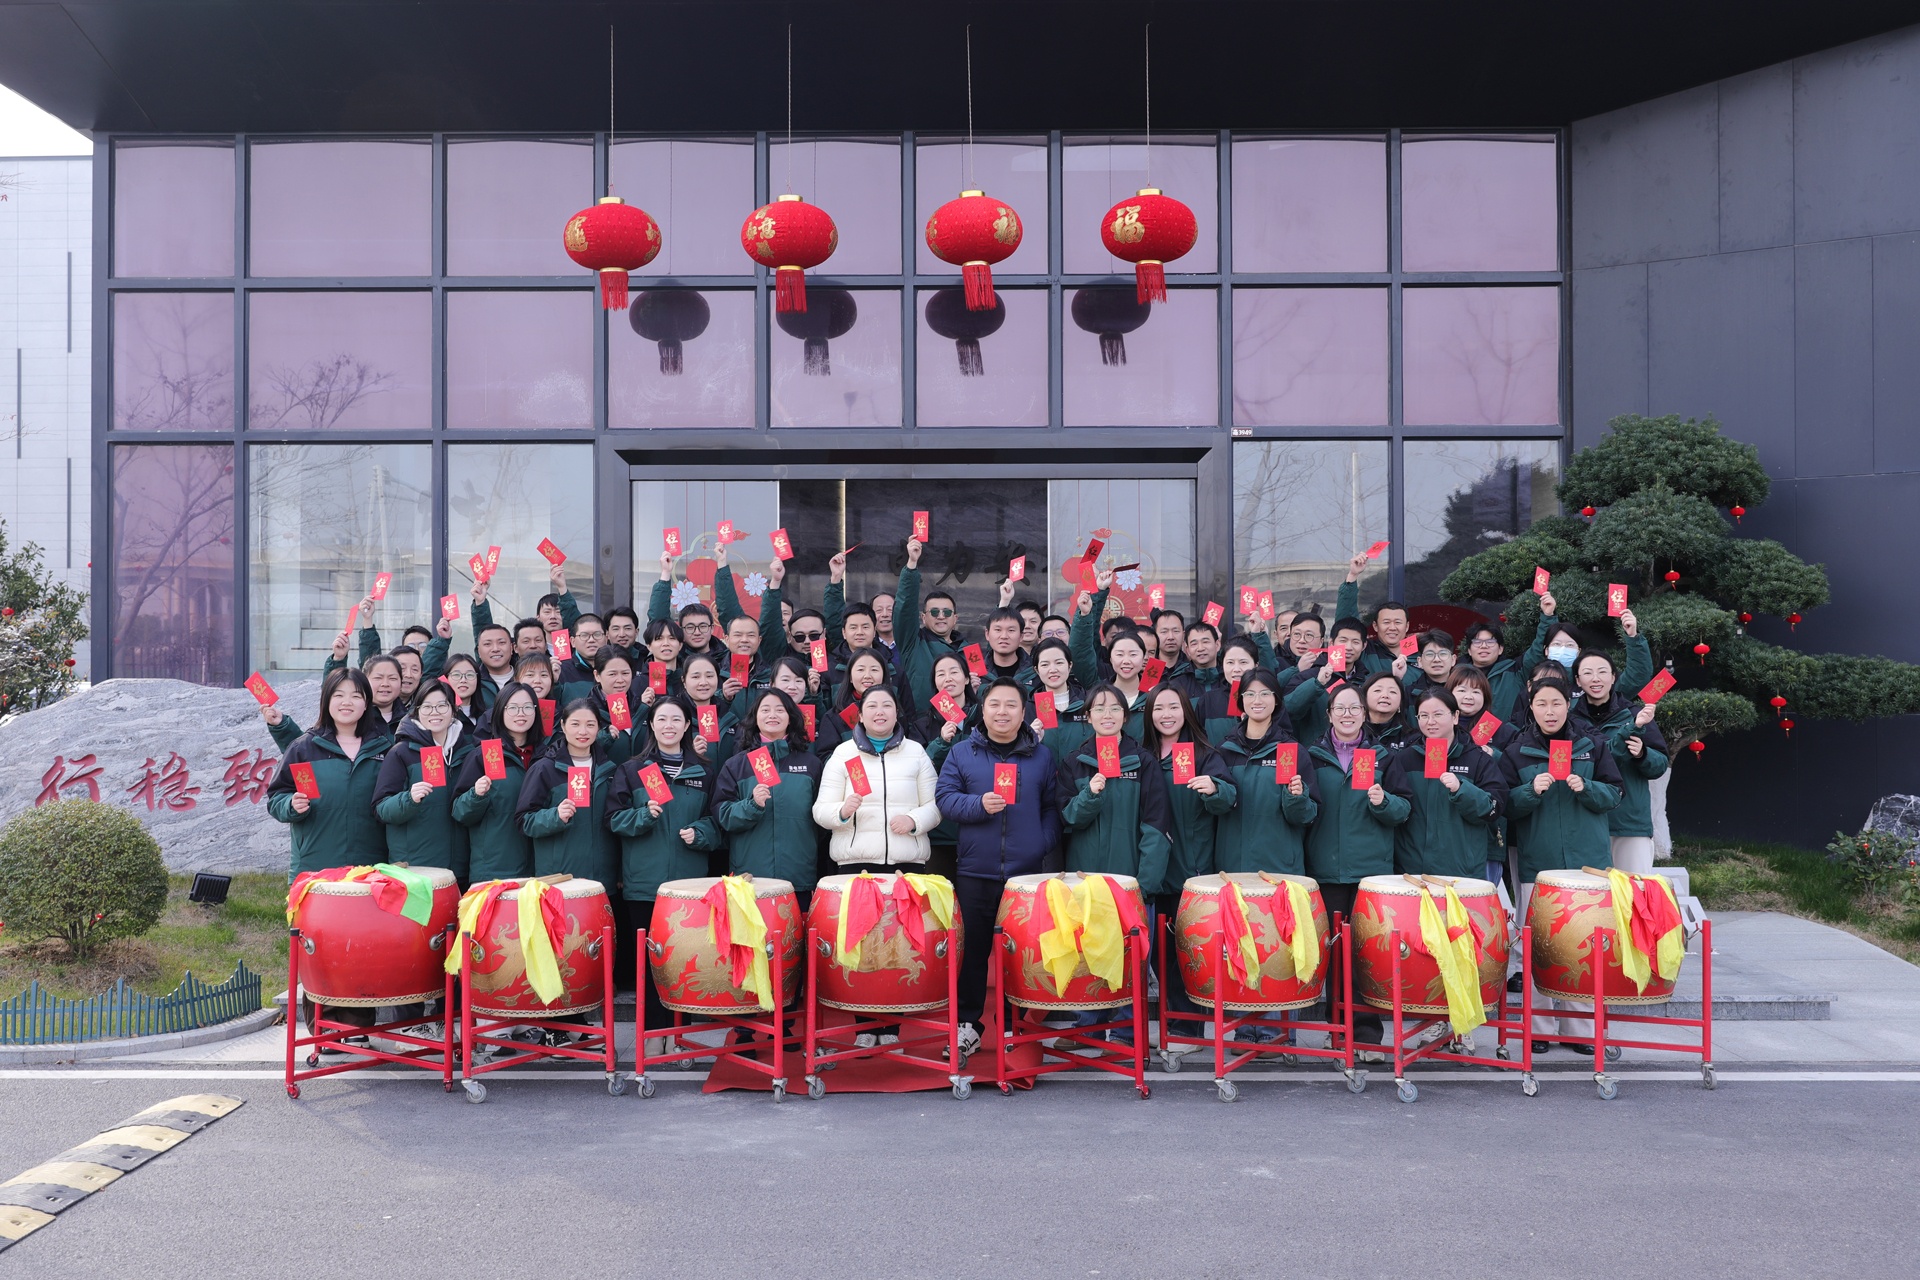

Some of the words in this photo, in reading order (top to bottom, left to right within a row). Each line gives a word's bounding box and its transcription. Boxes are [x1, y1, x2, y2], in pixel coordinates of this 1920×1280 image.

[1110, 205, 1145, 244] 福
[916, 517, 926, 529] 红
[720, 525, 730, 535] 红
[666, 534, 678, 545] 红
[774, 537, 787, 548] 红
[488, 551, 496, 562] 红
[376, 578, 386, 588] 红
[1150, 589, 1162, 599] 红
[1243, 591, 1254, 603] 红
[1611, 590, 1624, 602] 红
[444, 601, 456, 611] 红
[1260, 597, 1271, 609] 红
[555, 636, 567, 647] 红
[813, 646, 824, 659] 红
[1330, 650, 1343, 660] 红
[252, 682, 266, 694] 红
[611, 701, 626, 716] 红
[939, 700, 954, 712] 红
[1038, 701, 1053, 713] 红
[700, 713, 716, 728] 红
[485, 747, 501, 763] 红
[1100, 745, 1116, 760] 红
[1175, 751, 1191, 766] 红
[1279, 751, 1294, 766] 红
[1428, 747, 1444, 761] 红
[1552, 748, 1568, 762] 红
[424, 754, 441, 769] 红
[754, 756, 771, 772] 红
[1355, 757, 1371, 772] 红
[296, 770, 312, 783] 红
[851, 765, 864, 781] 红
[997, 771, 1013, 787] 红
[36, 749, 278, 811] 行稳致
[570, 774, 587, 789] 红
[646, 775, 663, 790] 红
